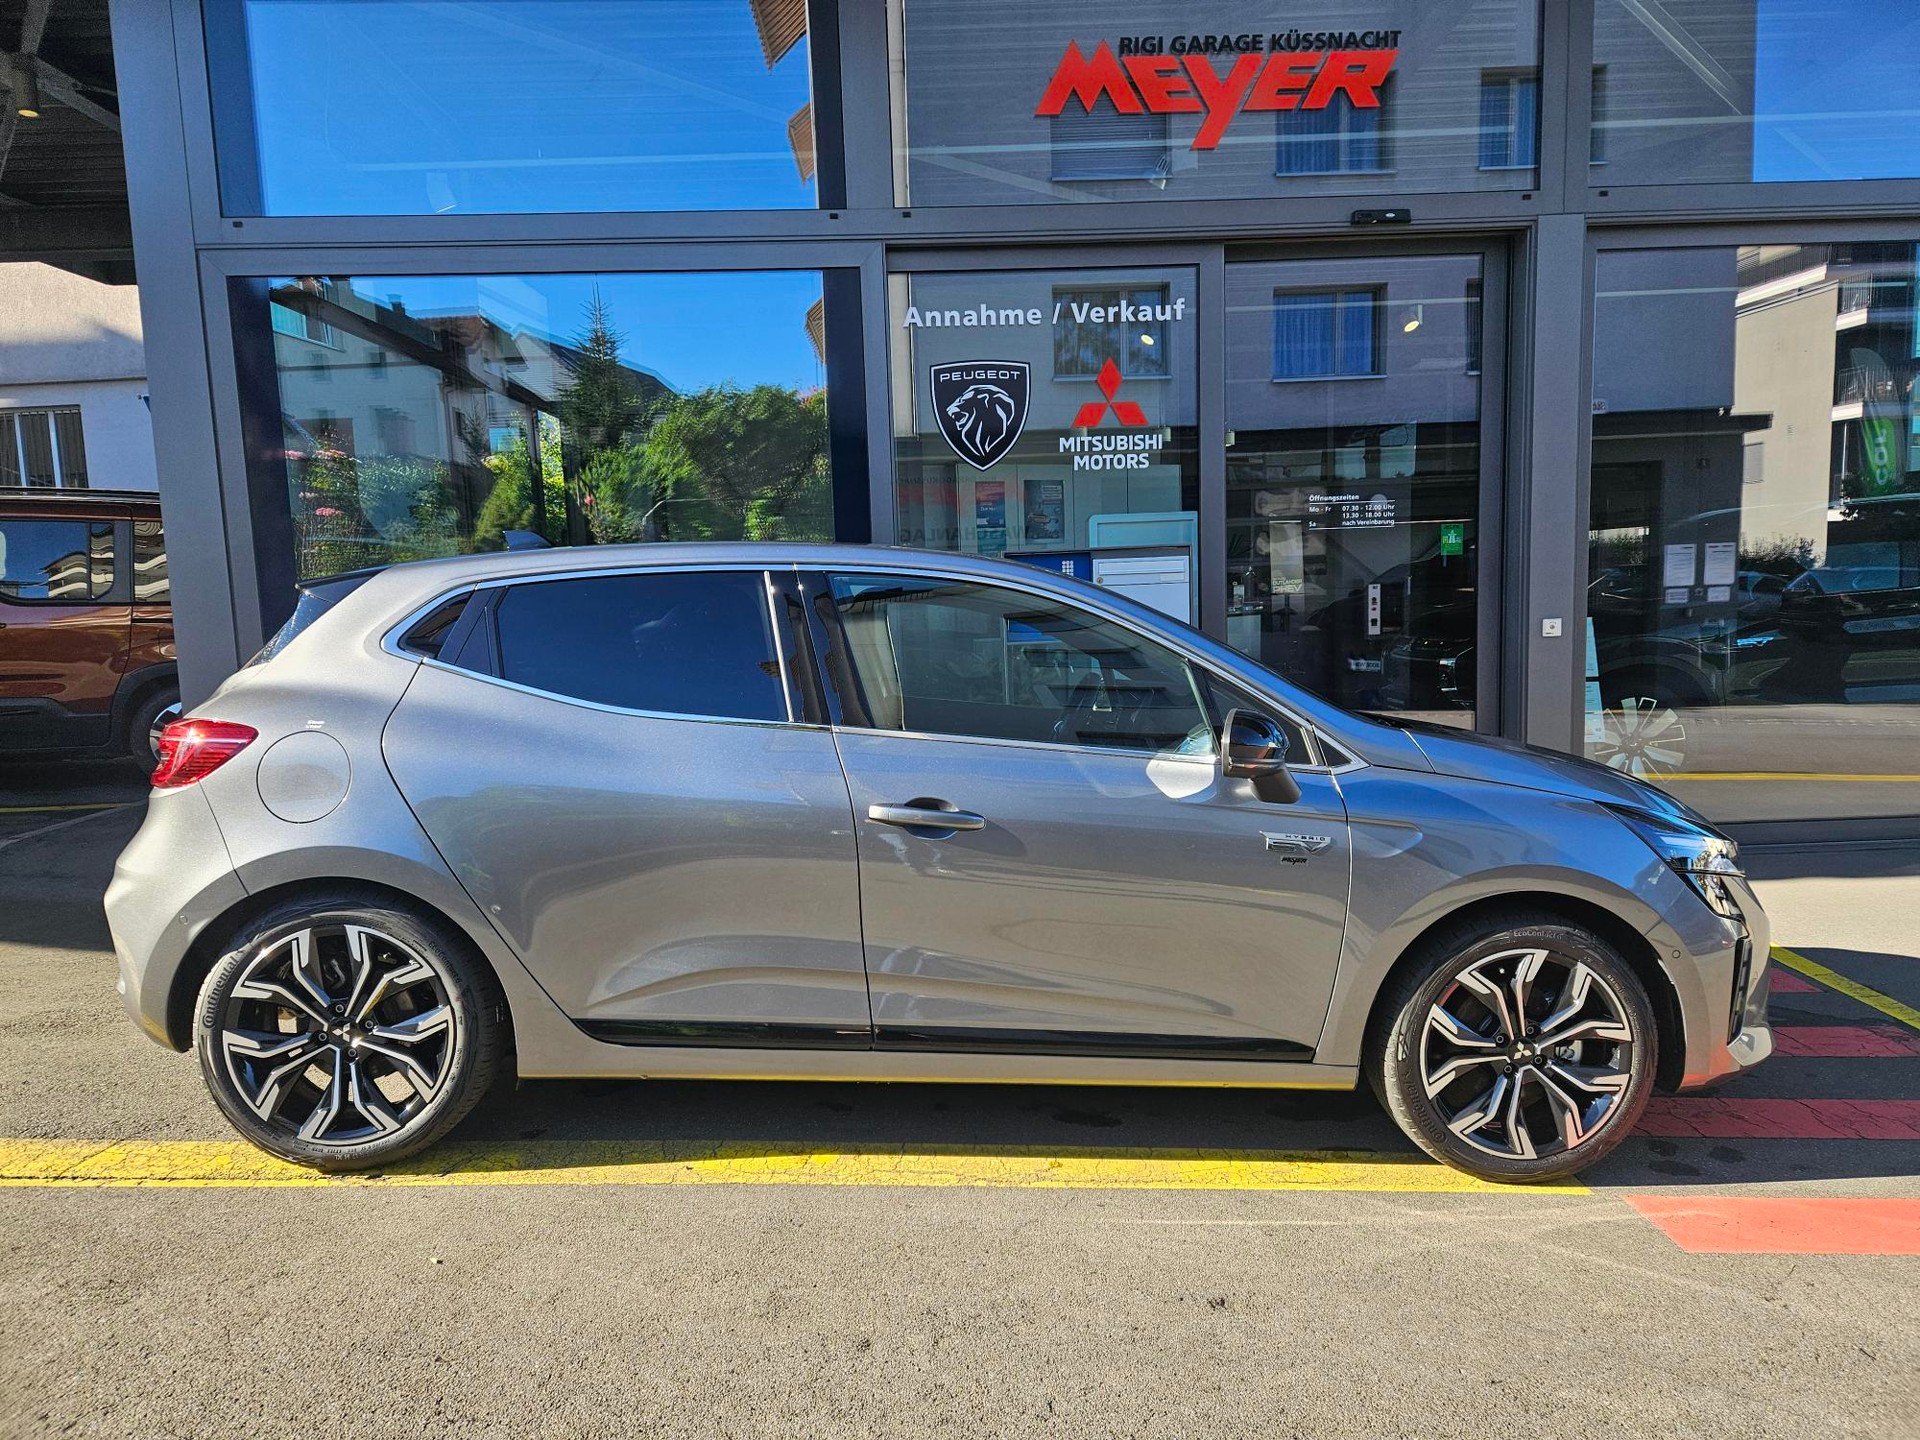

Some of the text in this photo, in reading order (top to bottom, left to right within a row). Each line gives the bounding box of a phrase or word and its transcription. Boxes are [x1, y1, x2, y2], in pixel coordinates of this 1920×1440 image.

[1119, 29, 1401, 54] RIGI GARAGE KÜSSNACHT
[1034, 38, 1399, 151] MEYER
[902, 297, 1185, 328] Annahme / Verkauf
[939, 370, 1021, 383] PEUGEOT
[1059, 434, 1163, 453] MITSUBISHI
[1073, 453, 1150, 471] MOTORS
[1309, 494, 1359, 502] Öffnungszeiten
[1357, 518, 1395, 526] Vereinbarung
[202, 955, 240, 1029] Continental
